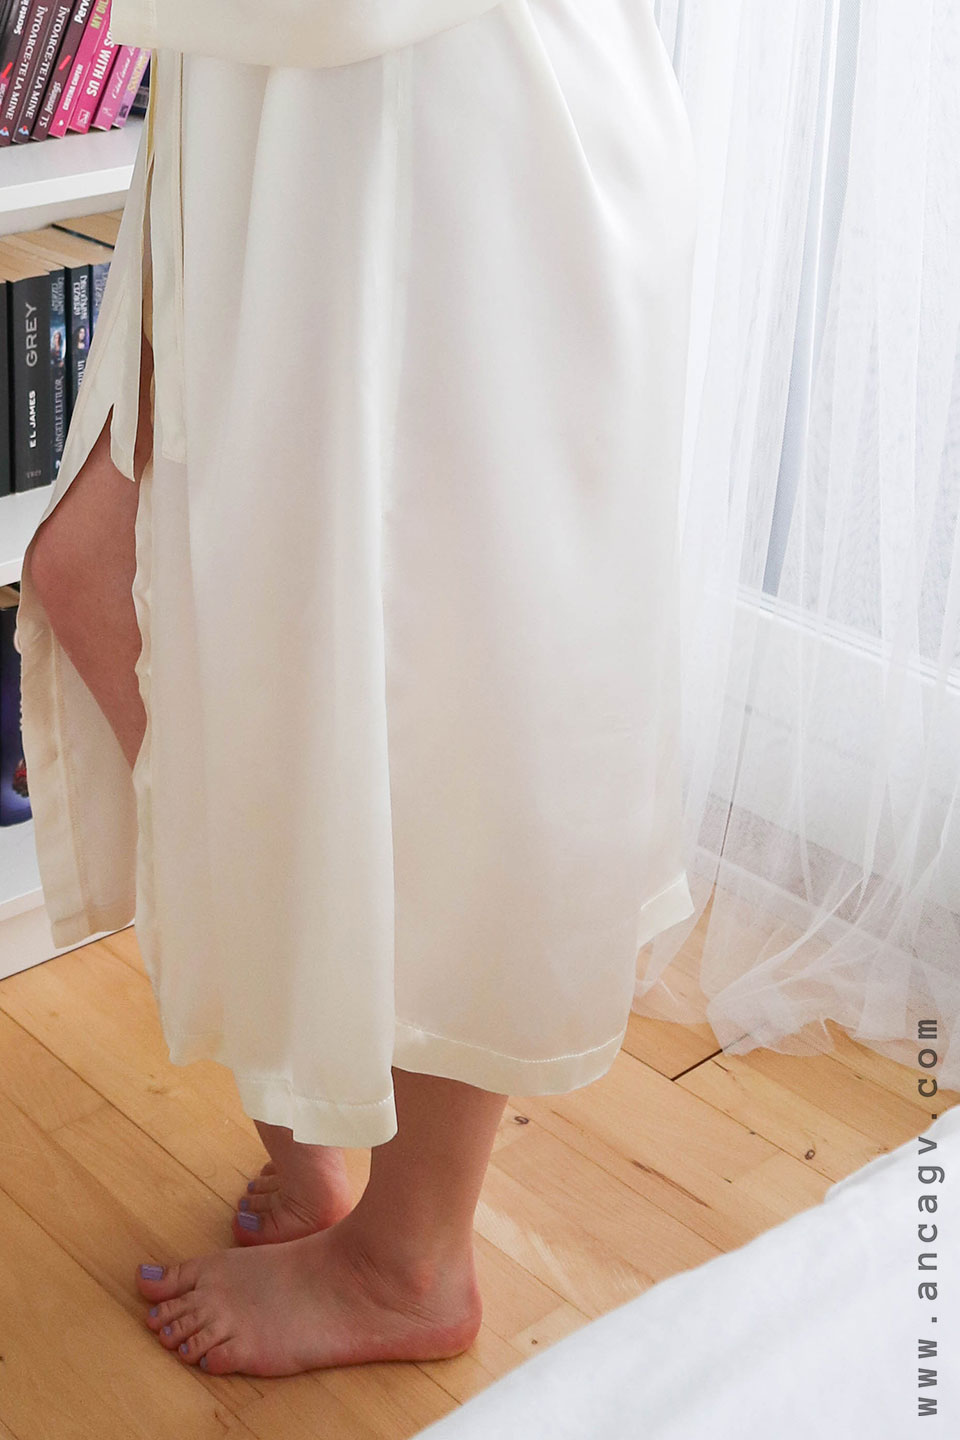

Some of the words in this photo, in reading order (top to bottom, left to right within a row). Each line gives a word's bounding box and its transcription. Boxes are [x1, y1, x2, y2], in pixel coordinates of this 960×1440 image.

[13, 4, 29, 35] Secrete
[20, 6, 48, 78] ÎNTOARCE-TE
[40, 6, 70, 77] ÎNTOARCE-TE
[93, 48, 111, 79] WITH
[13, 78, 26, 91] LA
[34, 77, 47, 90] LA
[86, 81, 100, 97] US
[5, 92, 22, 120] MINE
[26, 90, 42, 119] MINE
[25, 301, 38, 367] GREY
[28, 390, 37, 429] JAMES
[29, 430, 37, 438] L
[29, 440, 37, 448] E
